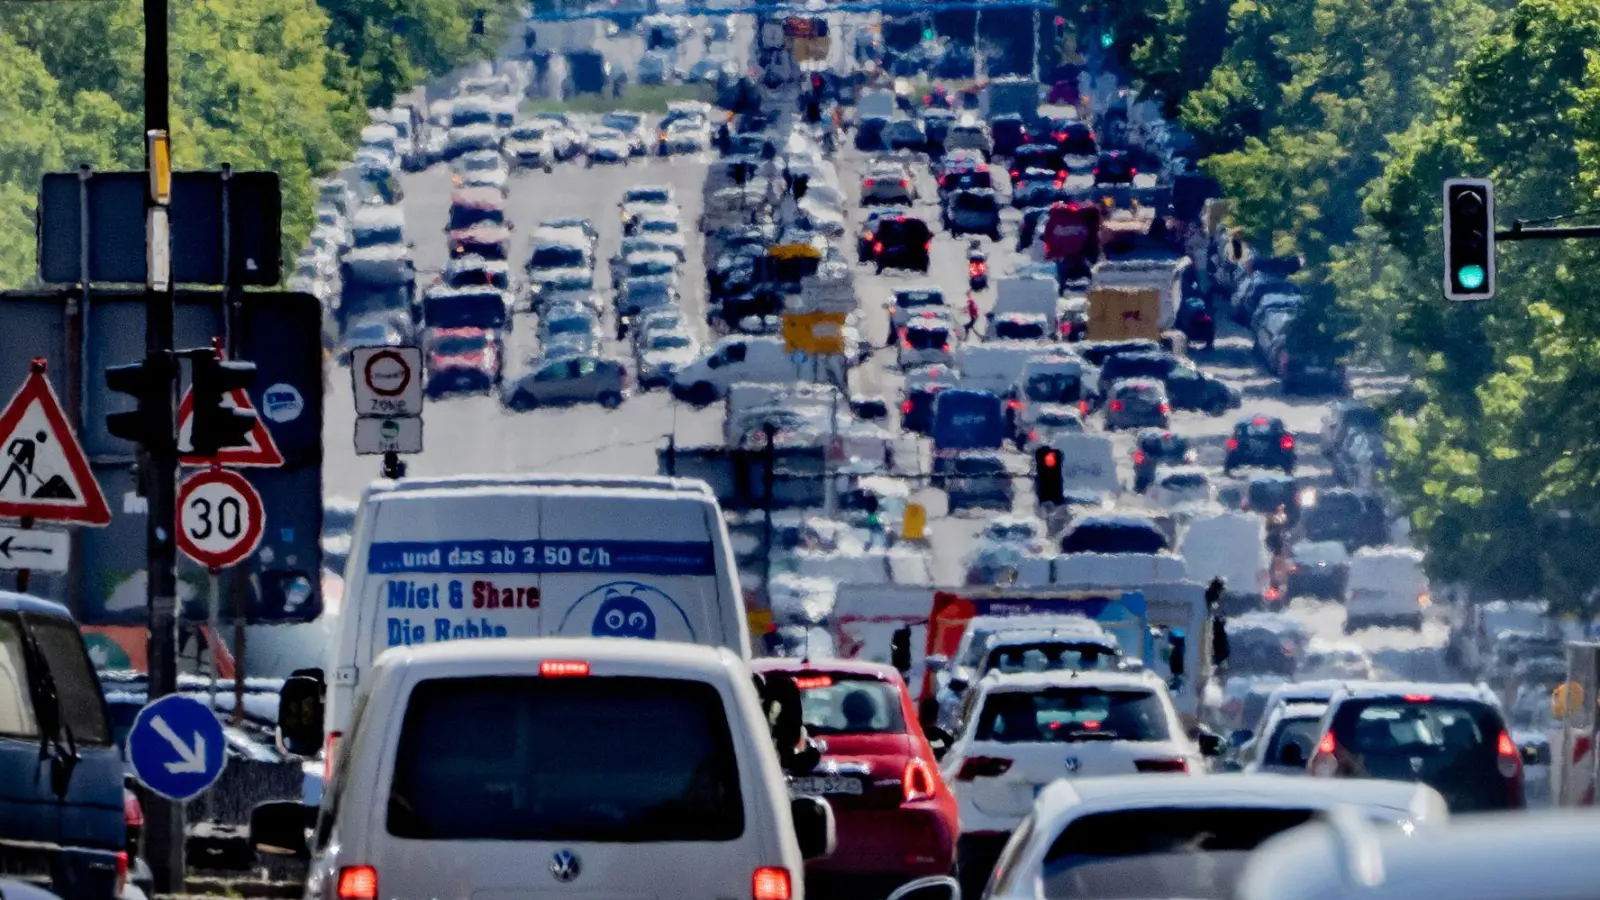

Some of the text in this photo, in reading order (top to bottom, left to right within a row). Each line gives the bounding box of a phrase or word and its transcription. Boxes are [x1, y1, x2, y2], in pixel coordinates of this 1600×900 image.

[190, 497, 241, 539] 30
[448, 547, 485, 566] das
[491, 547, 516, 565] ab
[388, 580, 439, 609] Miet
[472, 580, 541, 609] Share
[388, 617, 425, 644] Die
